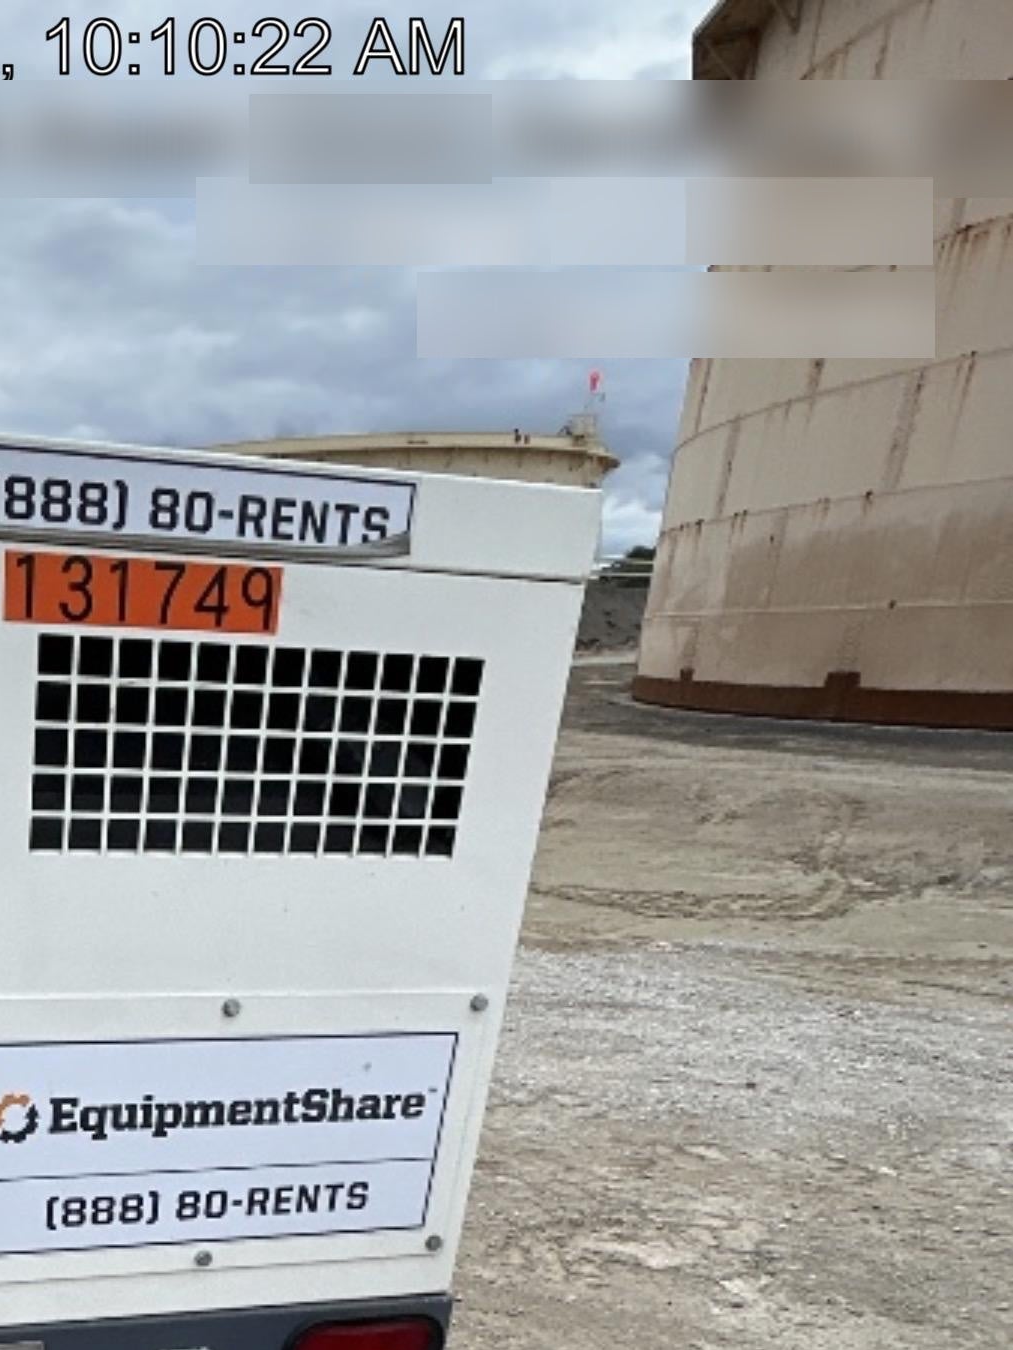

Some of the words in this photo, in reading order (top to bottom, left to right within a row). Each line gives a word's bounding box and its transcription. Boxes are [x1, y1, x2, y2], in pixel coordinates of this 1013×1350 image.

[148, 487, 391, 546] 80-RENTS
[15, 553, 275, 631] 131749
[48, 1087, 427, 1141] EquipmentShare
[45, 1190, 160, 1230] (888)
[175, 1181, 370, 1221] 80-RENTS
